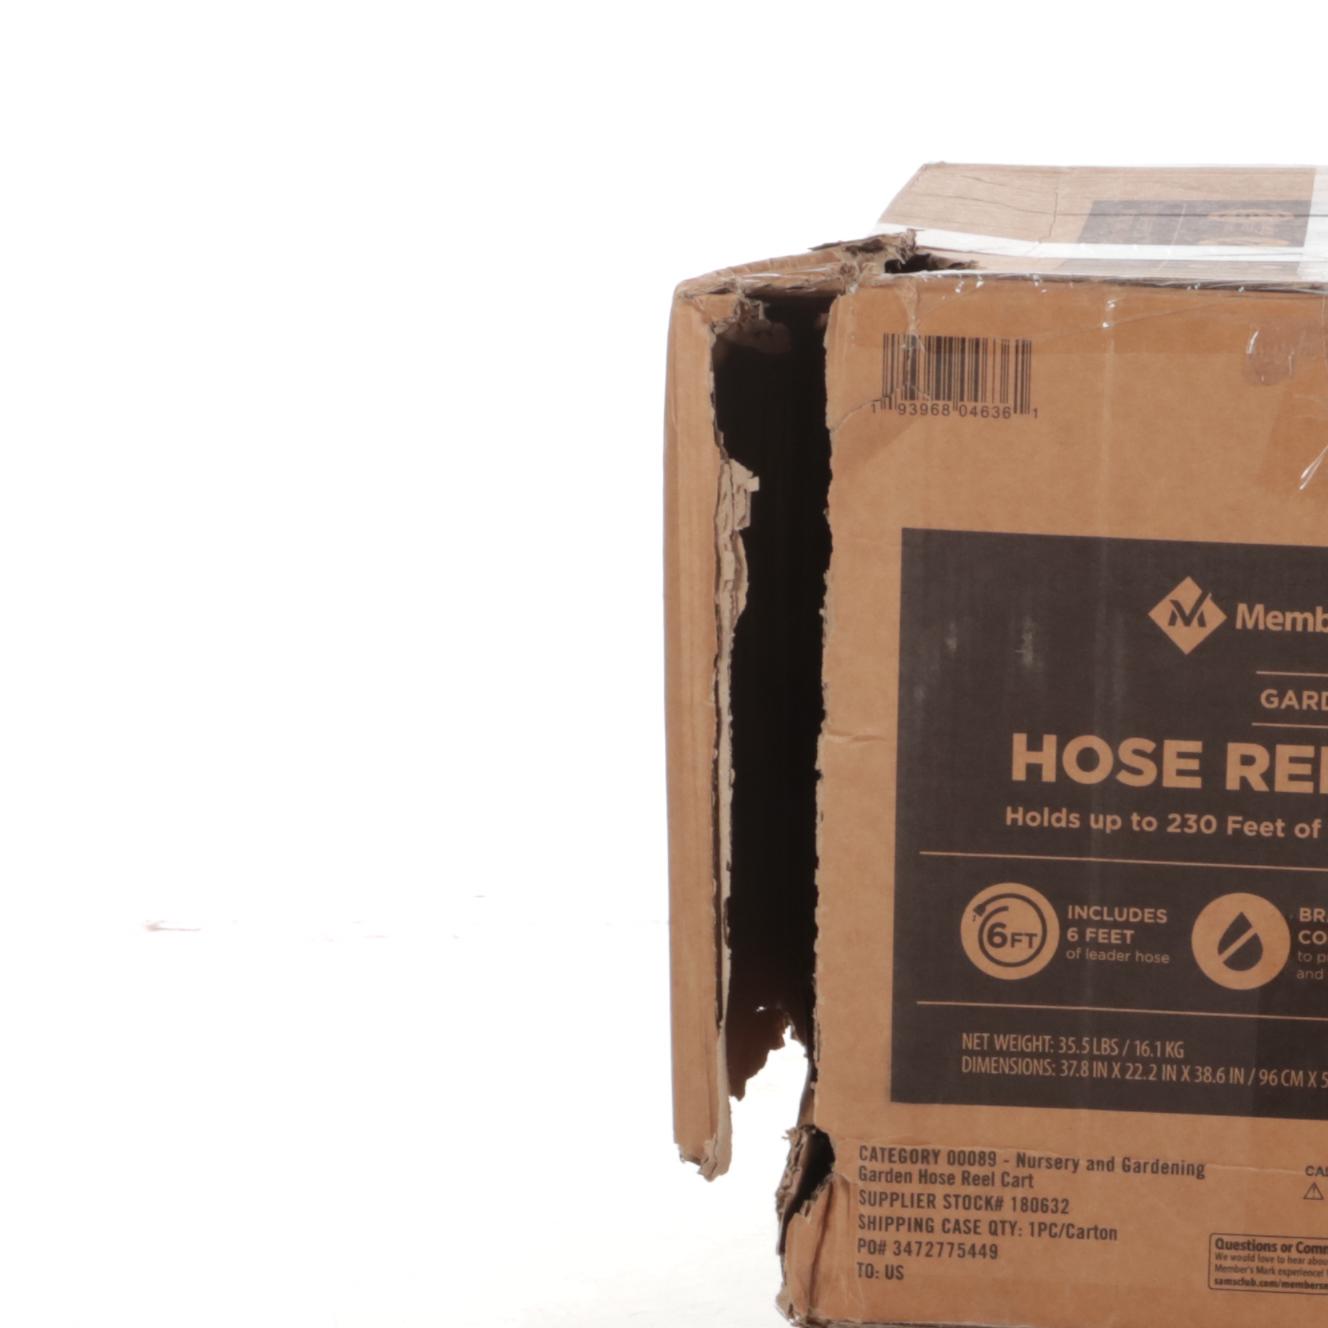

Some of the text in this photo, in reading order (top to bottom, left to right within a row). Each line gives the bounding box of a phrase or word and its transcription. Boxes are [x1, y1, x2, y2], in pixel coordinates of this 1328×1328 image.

[898, 403, 950, 416] 93968
[959, 405, 1012, 418] 04636
[1012, 734, 1202, 789] HOSE
[1005, 805, 1080, 831] Holds
[1090, 812, 1124, 838] up
[1132, 811, 1158, 833] to
[1167, 812, 1218, 835] 230
[1227, 815, 1286, 838] Feet
[1293, 816, 1322, 841] of
[1067, 905, 1168, 923] INCLUDES
[1067, 928, 1135, 944] 6 FEET
[1066, 947, 1170, 964] of leader hose
[1298, 950, 1311, 963] to
[1297, 968, 1324, 980] and
[962, 1033, 1184, 1058] NET WEIGHT: 35.5 LBS 16.1 KG
[962, 1056, 1056, 1076] DIMENSIONS:
[1060, 1060, 1089, 1078] 37.8
[1093, 1061, 1107, 1078] IN
[1111, 1062, 1121, 1079] X
[1126, 1063, 1157, 1080] 22.2
[1161, 1065, 1177, 1082] IN
[1180, 1066, 1191, 1083] X
[1195, 1066, 1225, 1084] 38.6
[1229, 1069, 1245, 1086] IN
[1259, 1070, 1279, 1088] 96
[1281, 1071, 1304, 1089] CM
[1307, 1072, 1318, 1089] X
[859, 1146, 1206, 1179] CATEGORY 00089 Nursery and Gardening
[859, 1166, 1035, 1189] Garden Hose Reel Cart
[859, 1190, 1070, 1215] SUPPLIER STOCK# 180632
[858, 1214, 1118, 1241] SHIPPING CASE QTY: 1PC/Carton
[858, 1238, 999, 1260] PO# 3472775449
[1215, 1237, 1277, 1253] Questions
[1280, 1243, 1293, 1253] or
[857, 1262, 904, 1281] TO: US
